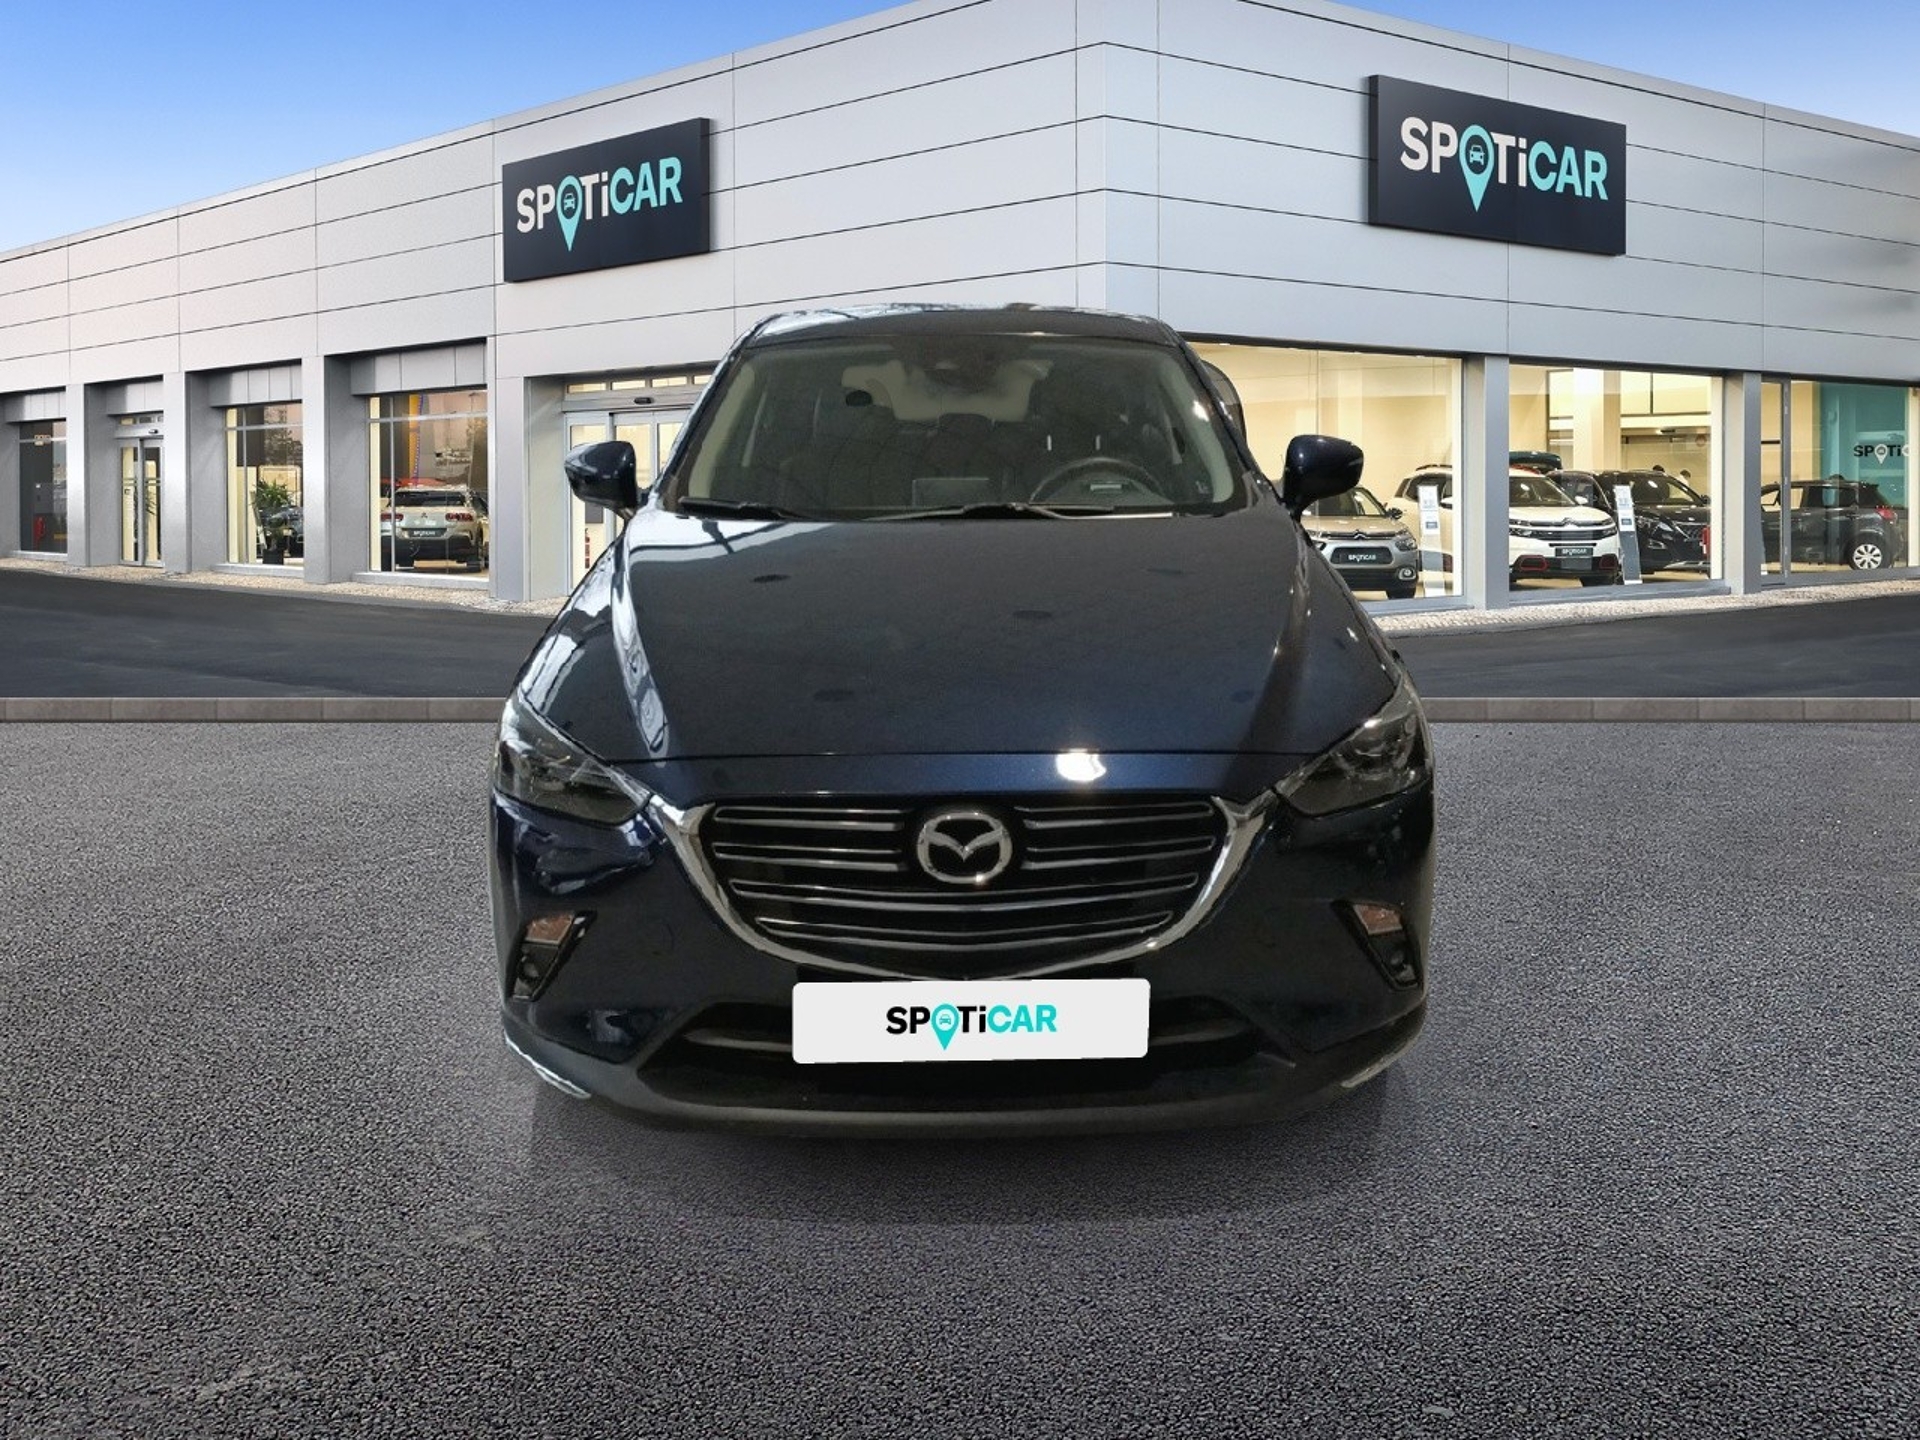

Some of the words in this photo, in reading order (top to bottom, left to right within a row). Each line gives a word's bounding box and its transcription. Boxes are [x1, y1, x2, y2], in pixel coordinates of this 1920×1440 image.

[516, 156, 683, 252] SPOTiCAR
[1400, 116, 1609, 212] SPOTiCAR
[886, 1003, 1057, 1050] SPOTiCAR
